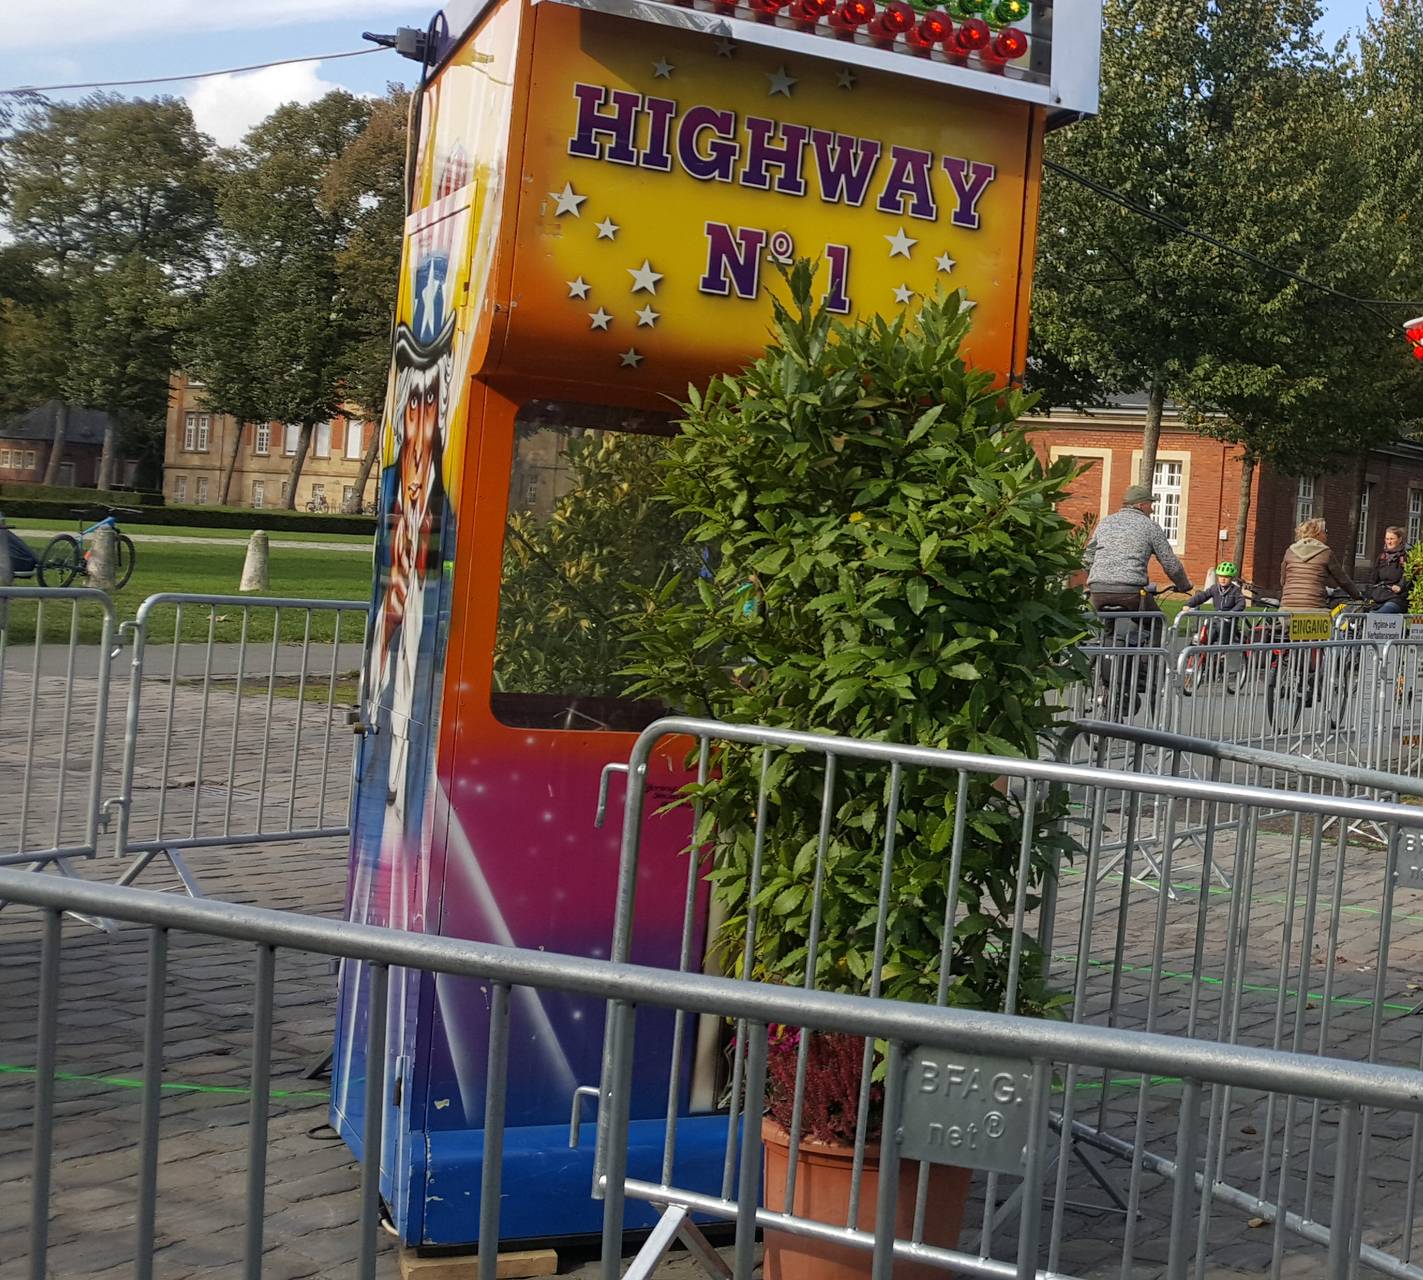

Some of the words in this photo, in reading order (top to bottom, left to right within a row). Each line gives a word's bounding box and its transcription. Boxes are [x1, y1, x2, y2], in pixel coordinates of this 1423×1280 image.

[567, 81, 995, 229] HIGHWAY
[823, 243, 851, 314] 1
[1292, 618, 1328, 634] EINGANG
